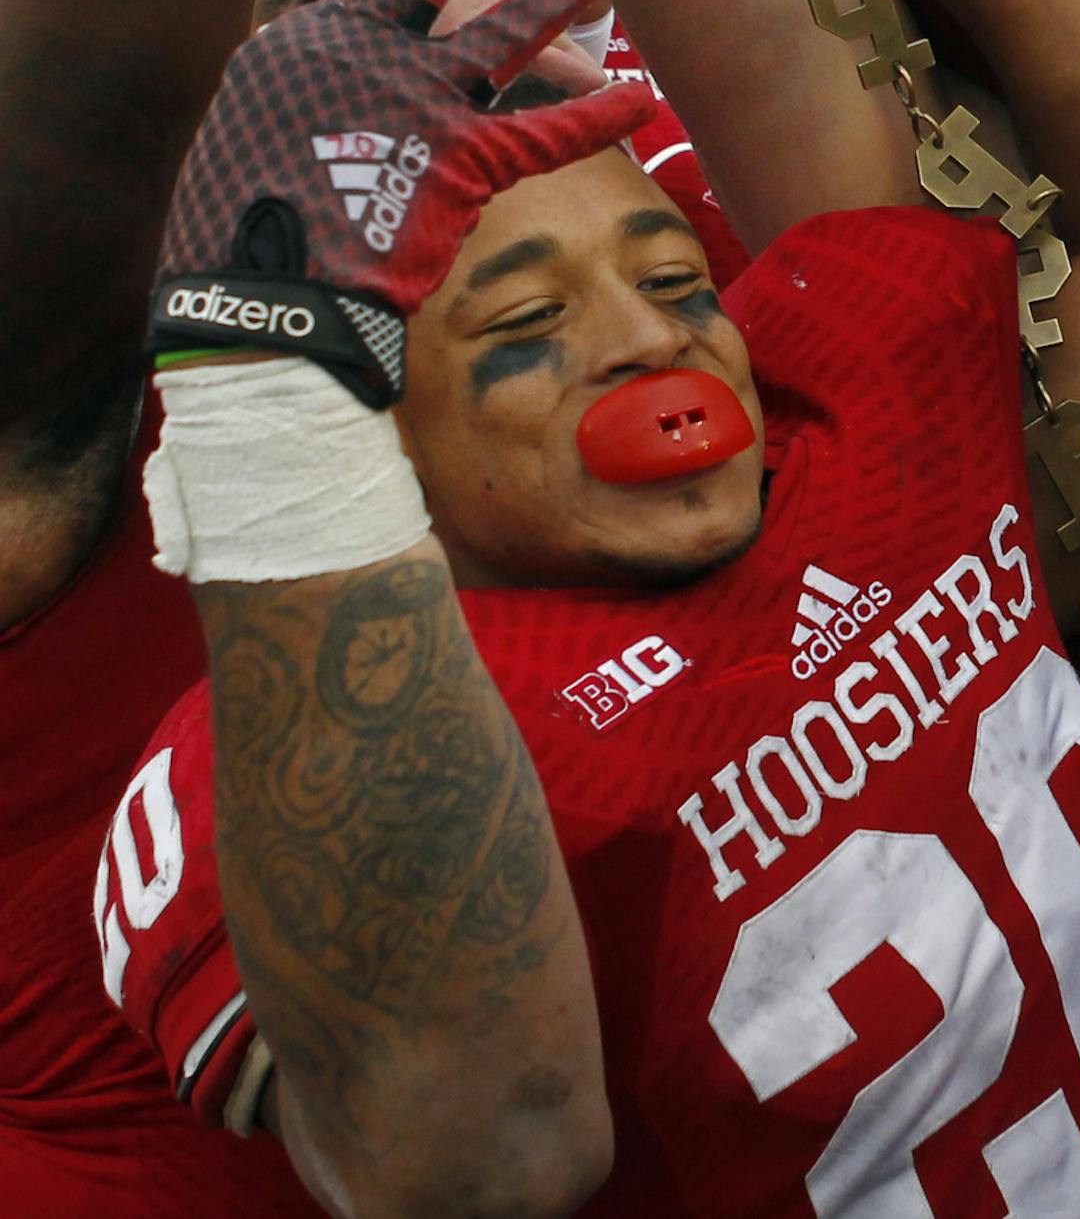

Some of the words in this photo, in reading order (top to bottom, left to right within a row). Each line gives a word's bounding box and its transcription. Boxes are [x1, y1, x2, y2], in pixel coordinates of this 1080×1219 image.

[364, 134, 432, 253] adidas
[166, 284, 316, 337] adizero
[790, 580, 893, 681] adidas
[677, 503, 1036, 901] HOOSIERS
